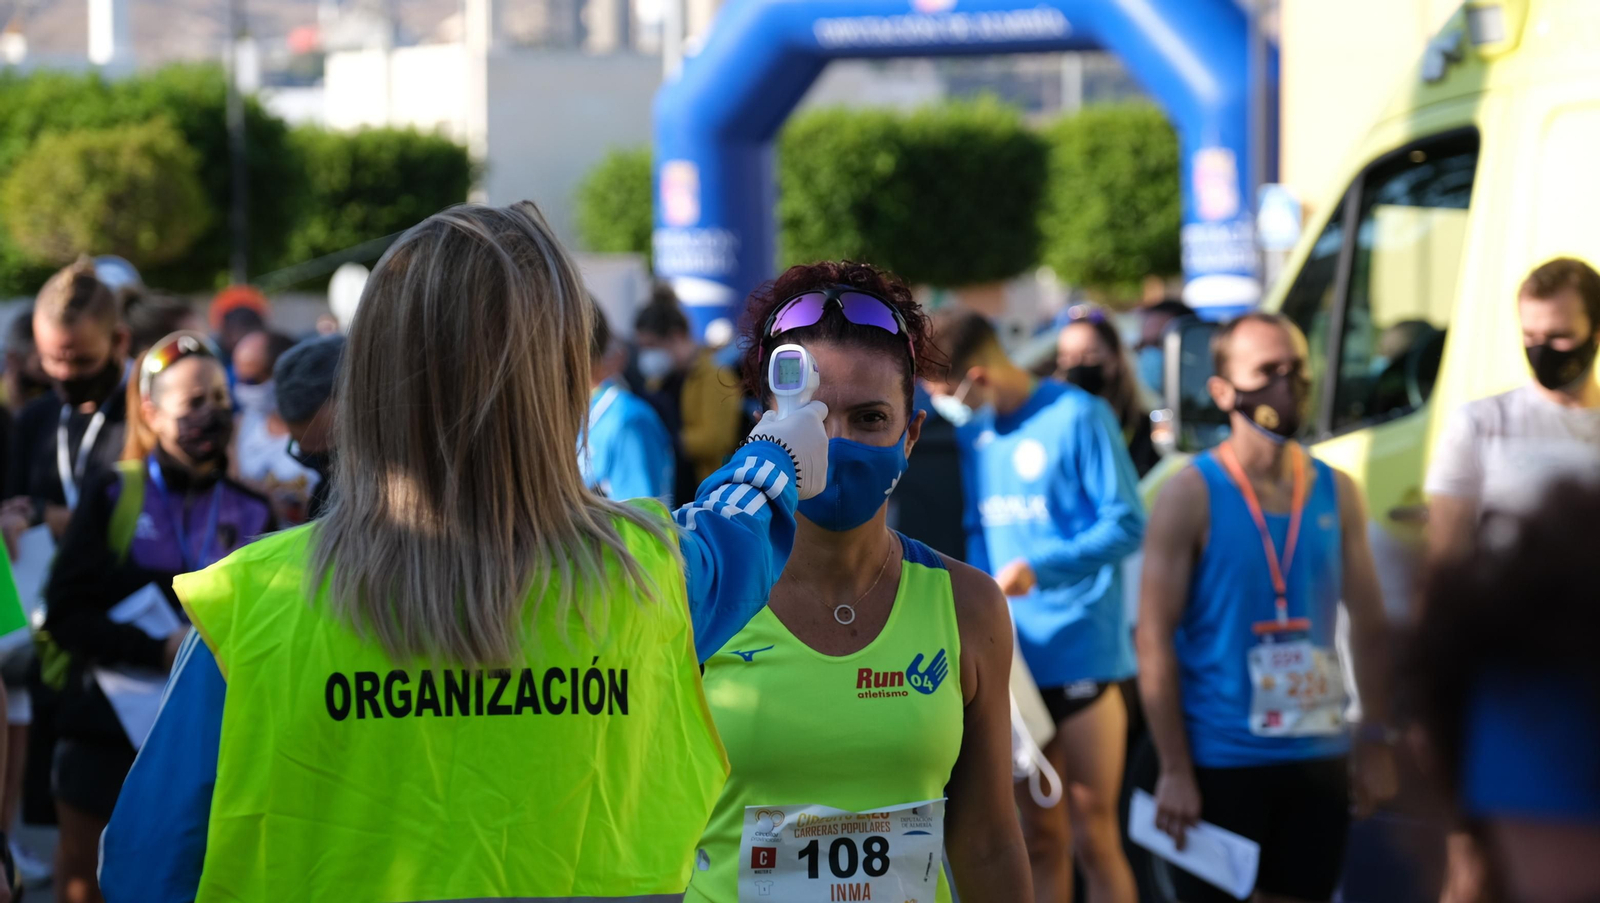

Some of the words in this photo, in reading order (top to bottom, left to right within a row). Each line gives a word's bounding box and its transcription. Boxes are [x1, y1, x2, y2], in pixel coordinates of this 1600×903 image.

[325, 656, 629, 721] ORGANIZACIÓN
[856, 667, 904, 689] Run
[910, 674, 934, 691] 04
[857, 690, 909, 698] atletismo
[794, 823, 839, 838] CARRERAS
[840, 820, 891, 835] POPULARES
[759, 851, 768, 866] C
[798, 836, 890, 879] 108
[830, 882, 871, 902] INMA
